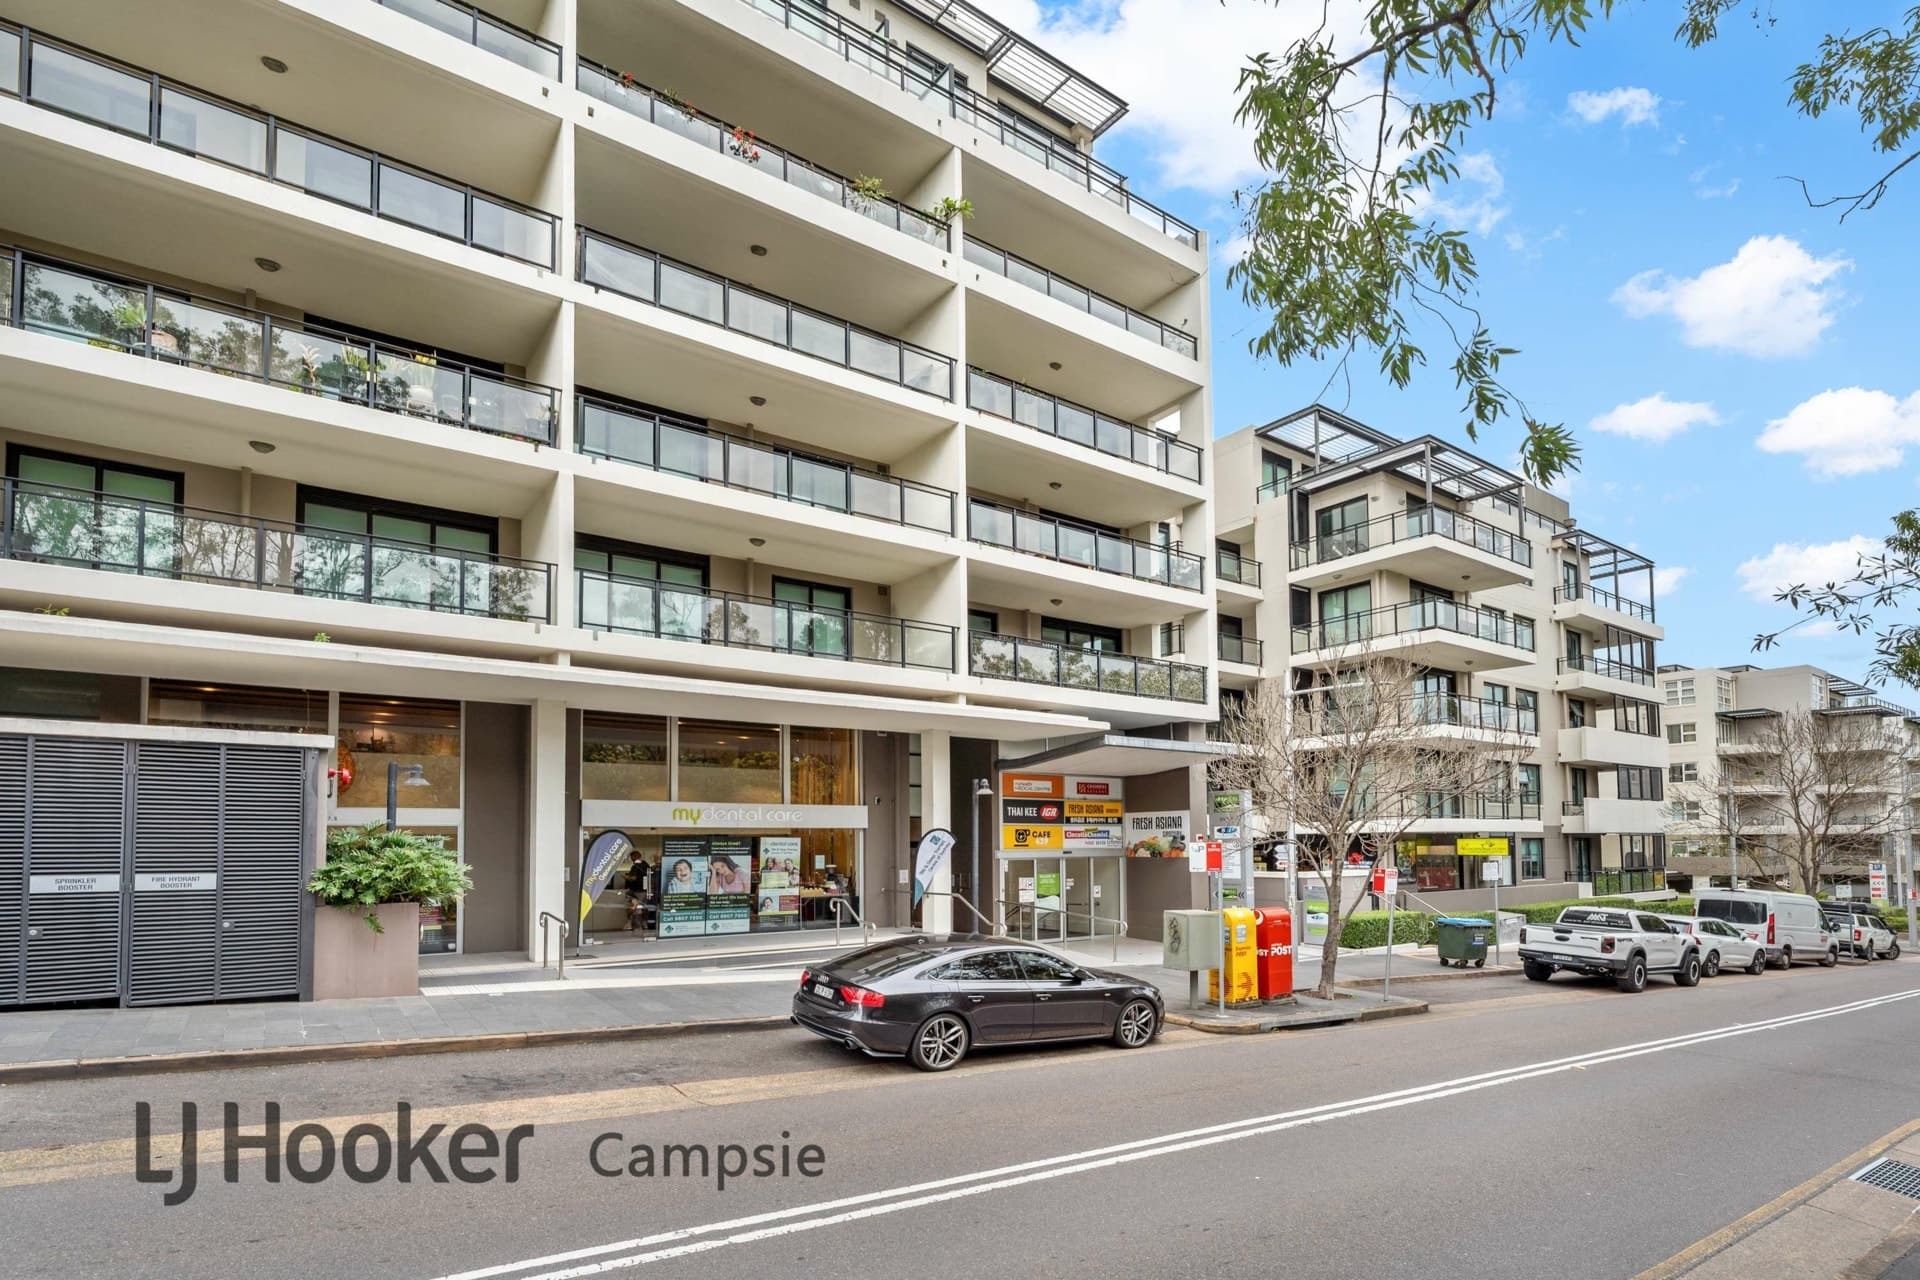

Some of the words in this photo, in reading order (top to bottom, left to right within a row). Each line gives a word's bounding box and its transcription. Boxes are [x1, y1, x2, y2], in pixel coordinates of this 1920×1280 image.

[766, 809, 803, 821] care
[1007, 806, 1024, 816] THAI
[1024, 807, 1038, 816] KEE
[1041, 807, 1058, 817] IGA
[1132, 816, 1153, 830] FRESH
[1155, 815, 1183, 829] ASIANA
[1271, 945, 1292, 956] POST
